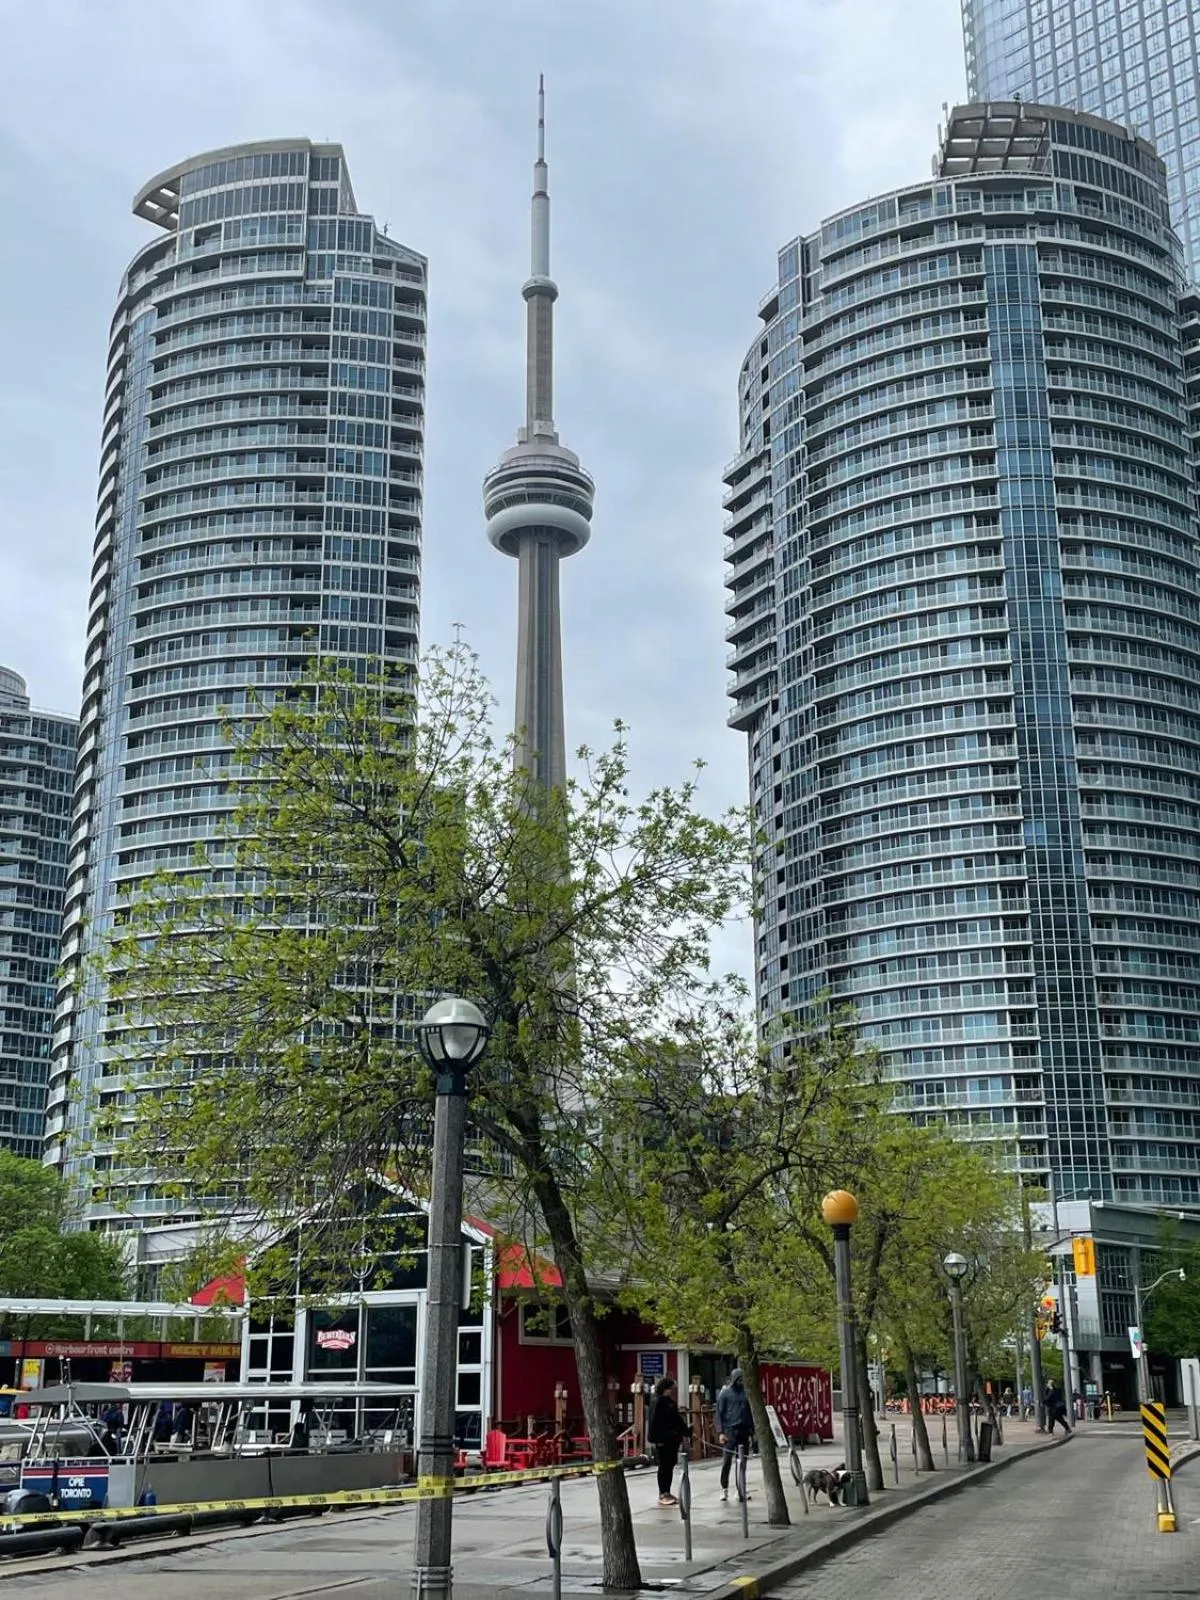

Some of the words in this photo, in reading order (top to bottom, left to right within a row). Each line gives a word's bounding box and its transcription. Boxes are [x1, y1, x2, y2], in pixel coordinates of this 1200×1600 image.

[55, 1343, 107, 1355] Harbourfront
[109, 1345, 135, 1355] centre
[60, 1488, 92, 1498] TORONTO
